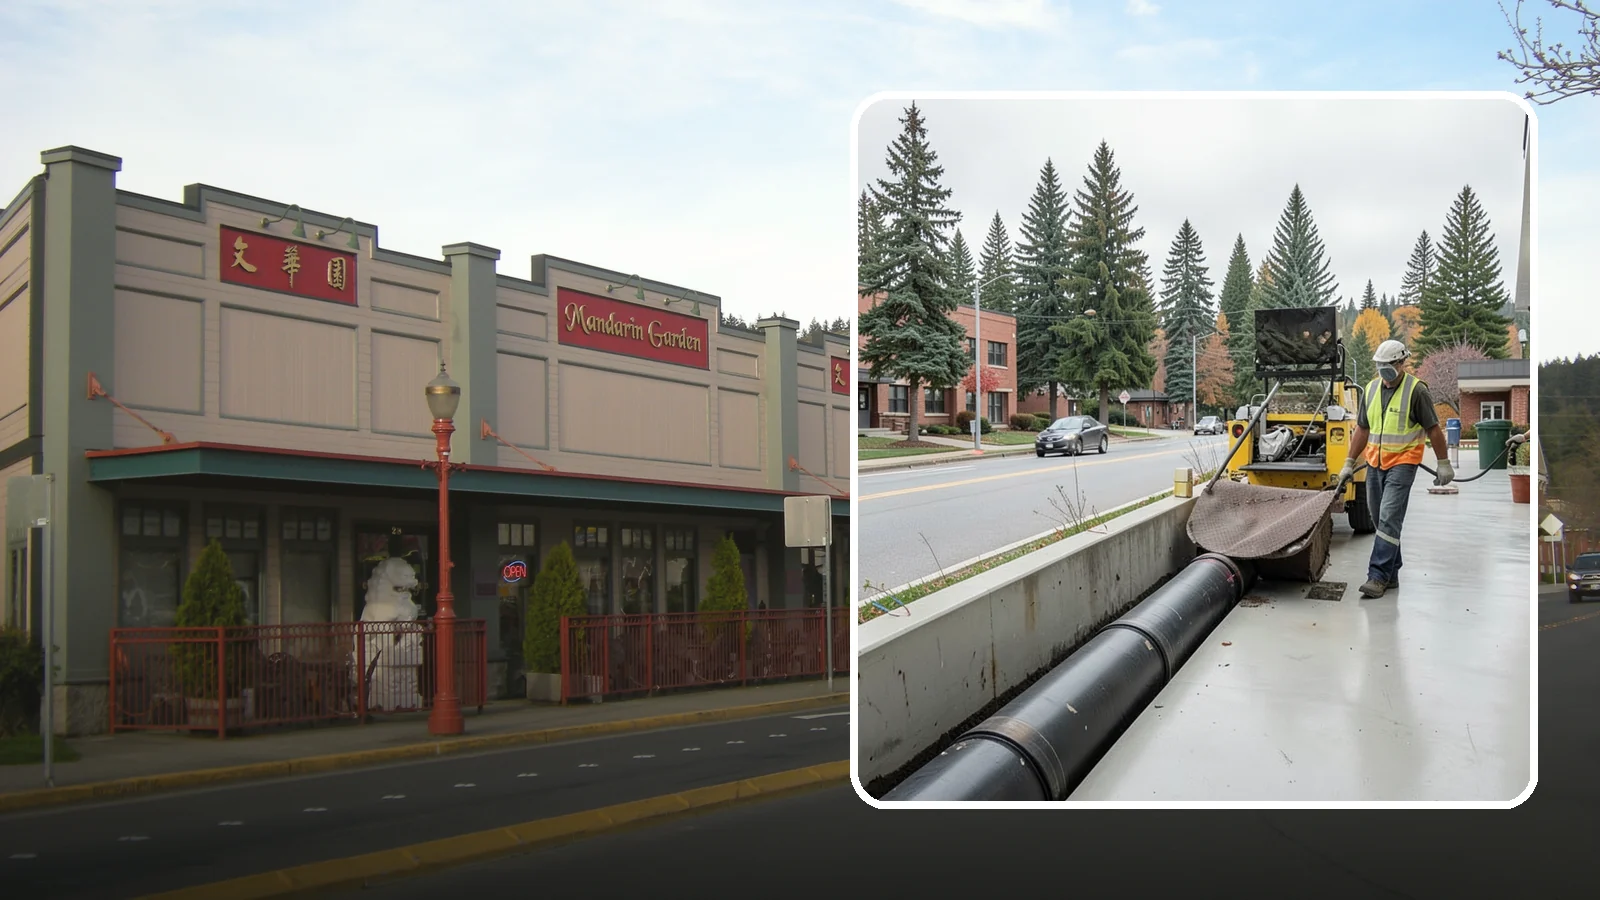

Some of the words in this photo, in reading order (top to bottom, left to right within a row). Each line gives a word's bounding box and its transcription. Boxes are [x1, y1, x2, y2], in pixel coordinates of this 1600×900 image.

[231, 236, 346, 290] 文華園
[564, 302, 644, 341] Mandarin
[647, 320, 701, 351] Garden
[503, 565, 527, 578] OPEN
